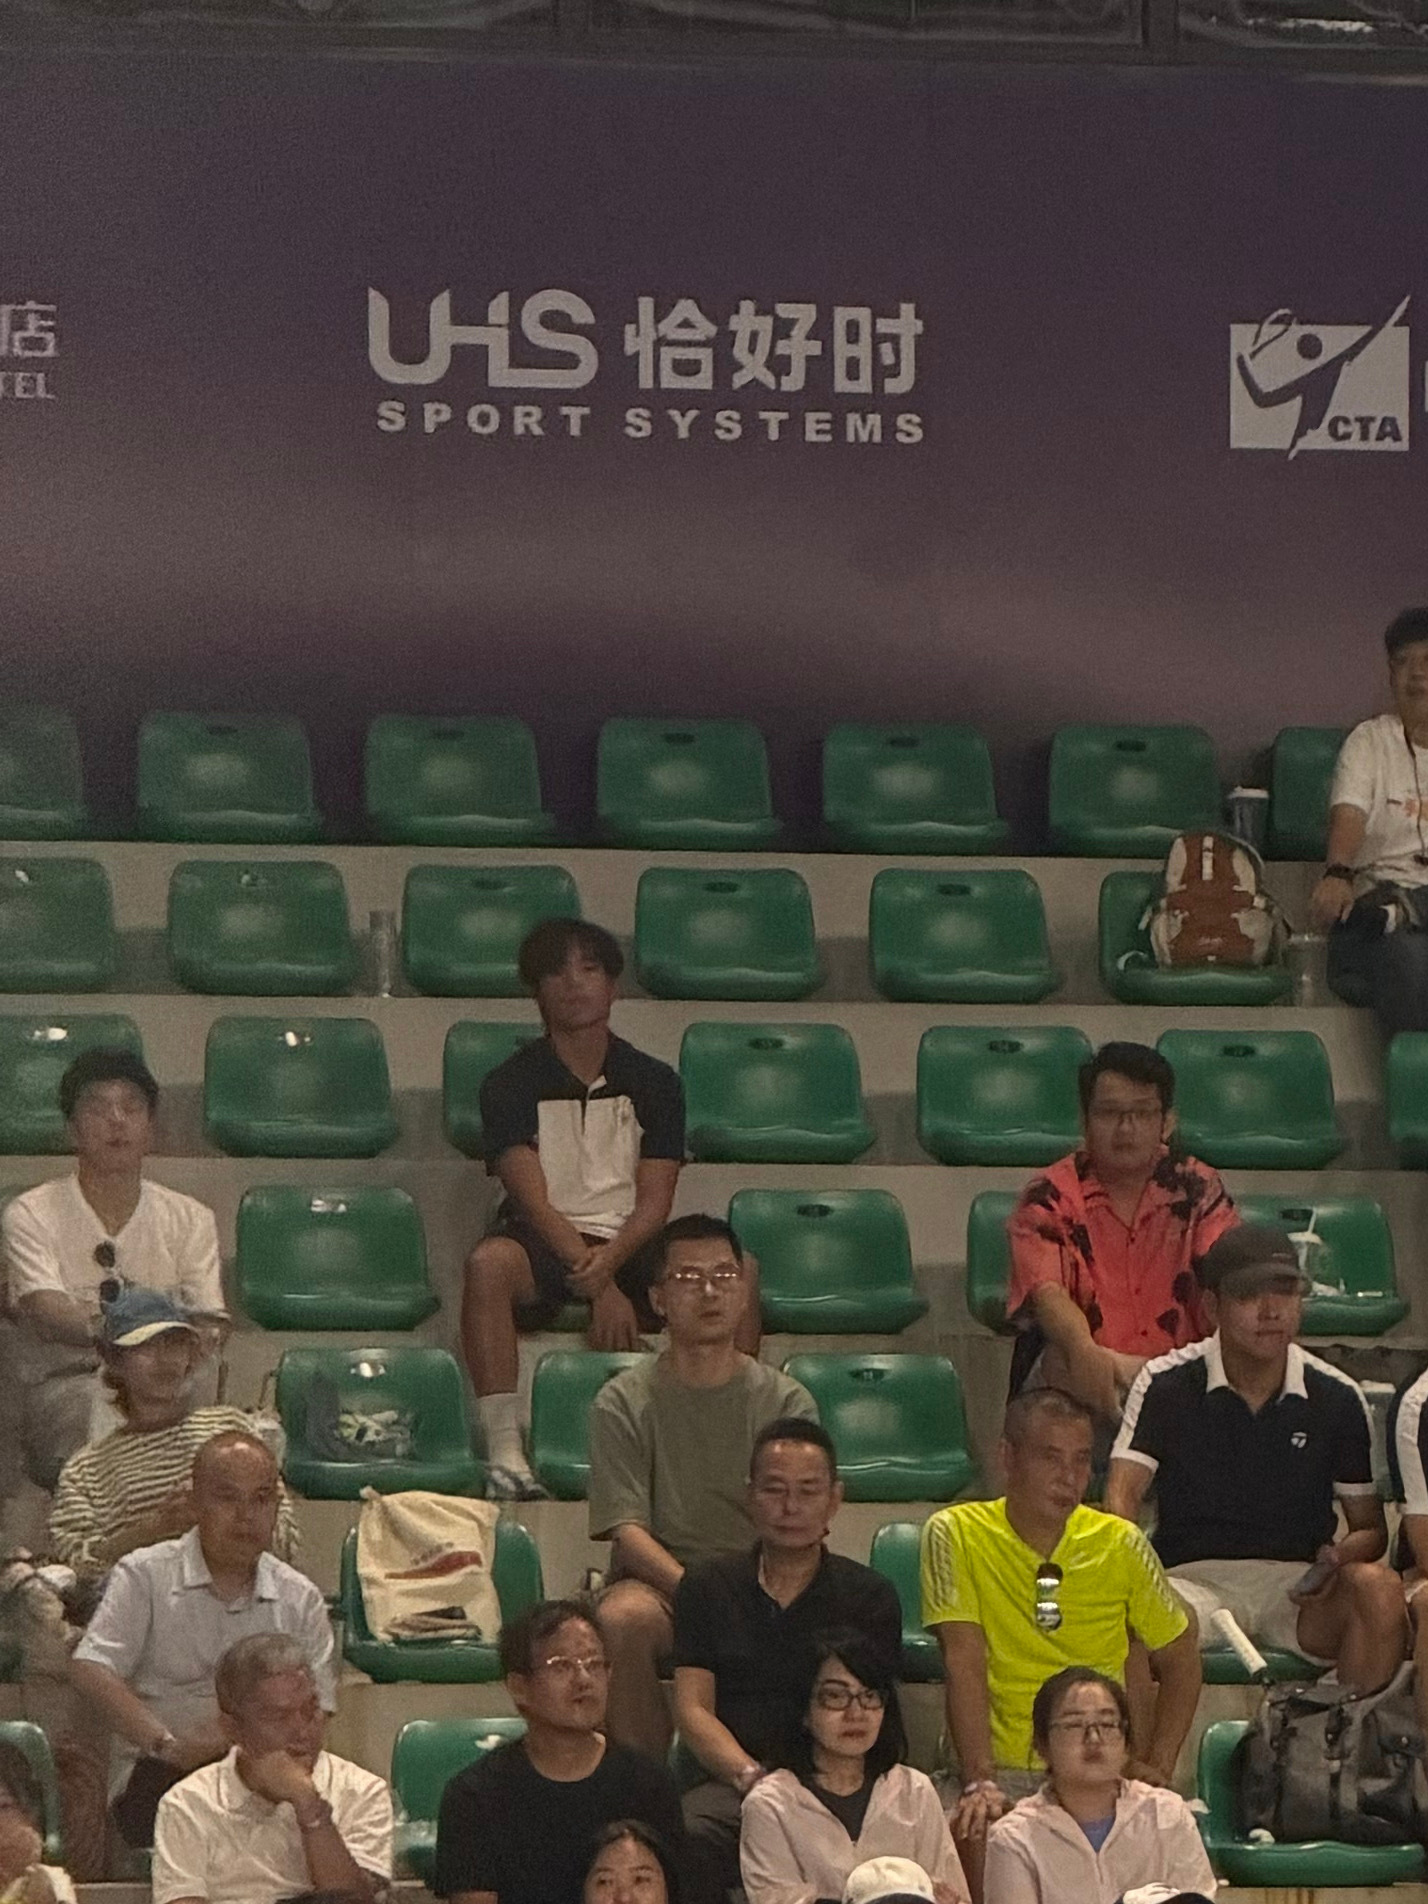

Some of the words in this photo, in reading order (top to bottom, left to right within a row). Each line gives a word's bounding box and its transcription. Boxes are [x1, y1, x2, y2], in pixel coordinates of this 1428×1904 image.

[623, 296, 924, 395] 恰好时
[377, 400, 591, 437] SPORT
[624, 407, 924, 444] SYSTEMS
[1326, 412, 1403, 443] CTA
